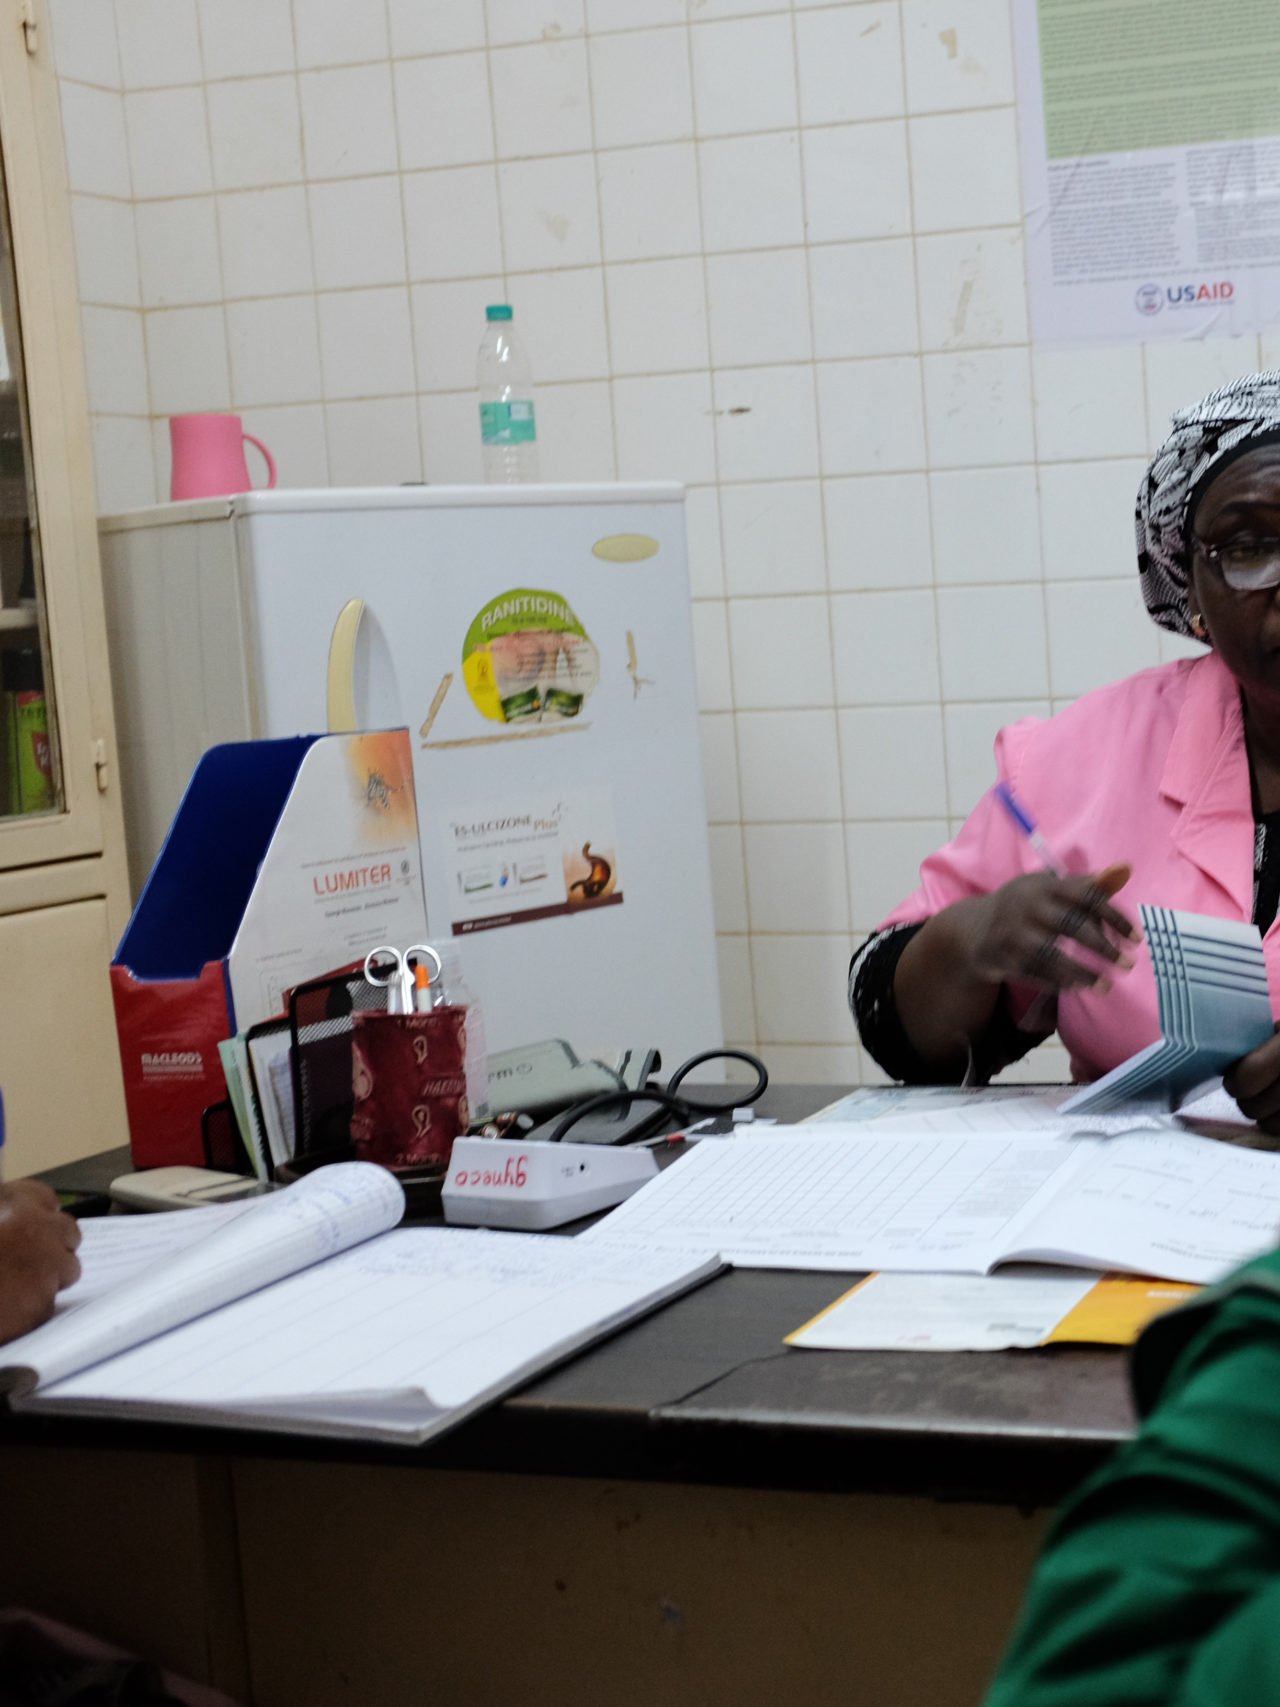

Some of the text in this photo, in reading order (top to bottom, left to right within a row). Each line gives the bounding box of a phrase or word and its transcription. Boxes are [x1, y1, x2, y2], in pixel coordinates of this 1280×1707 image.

[1166, 281, 1234, 303] USAID
[481, 595, 575, 632] RANITIDINE
[313, 863, 391, 896] LUMITER
[141, 1052, 202, 1065] MACLEODS
[455, 1155, 529, 1188] gyneco
